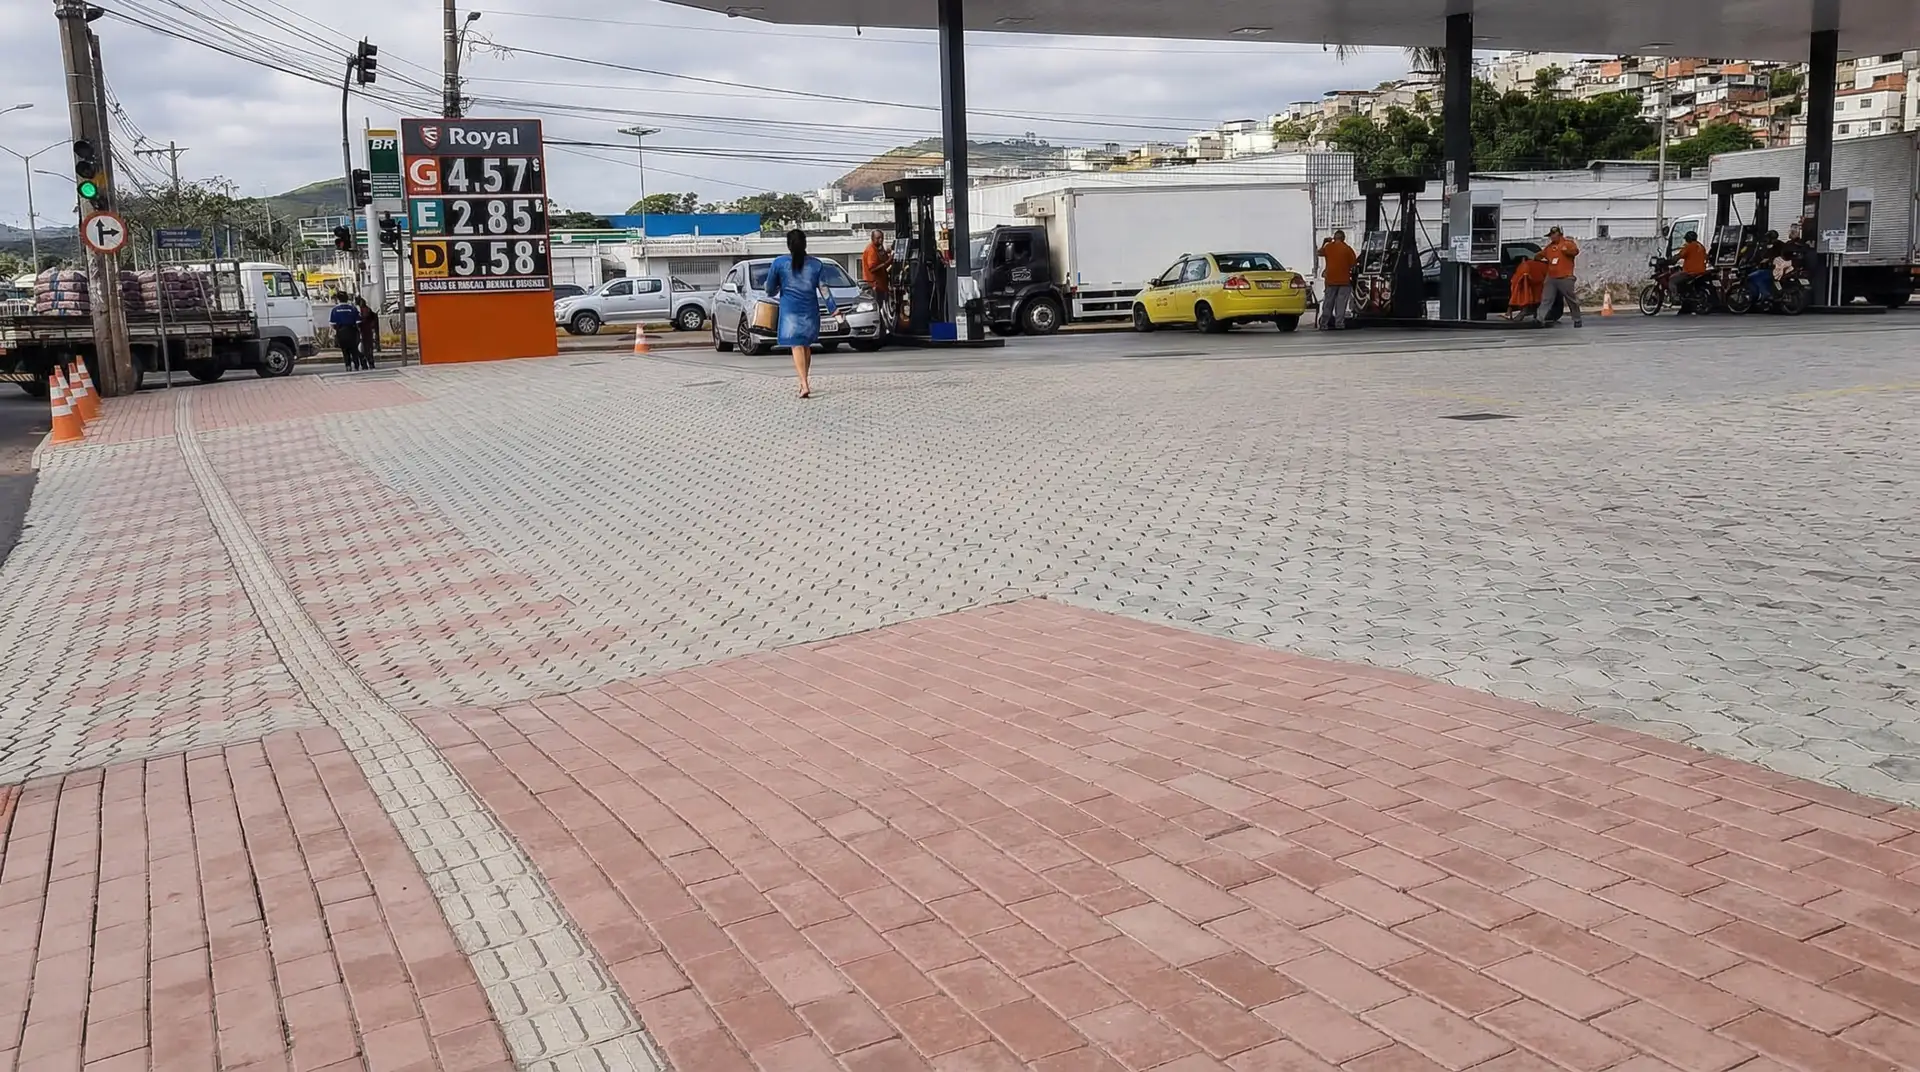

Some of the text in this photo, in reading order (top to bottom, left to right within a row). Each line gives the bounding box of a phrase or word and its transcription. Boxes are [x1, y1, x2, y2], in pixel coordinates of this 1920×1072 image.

[371, 139, 395, 151] BR
[448, 127, 519, 150] Royal
[409, 158, 438, 186] G
[417, 201, 439, 228] E
[417, 244, 445, 269] D
